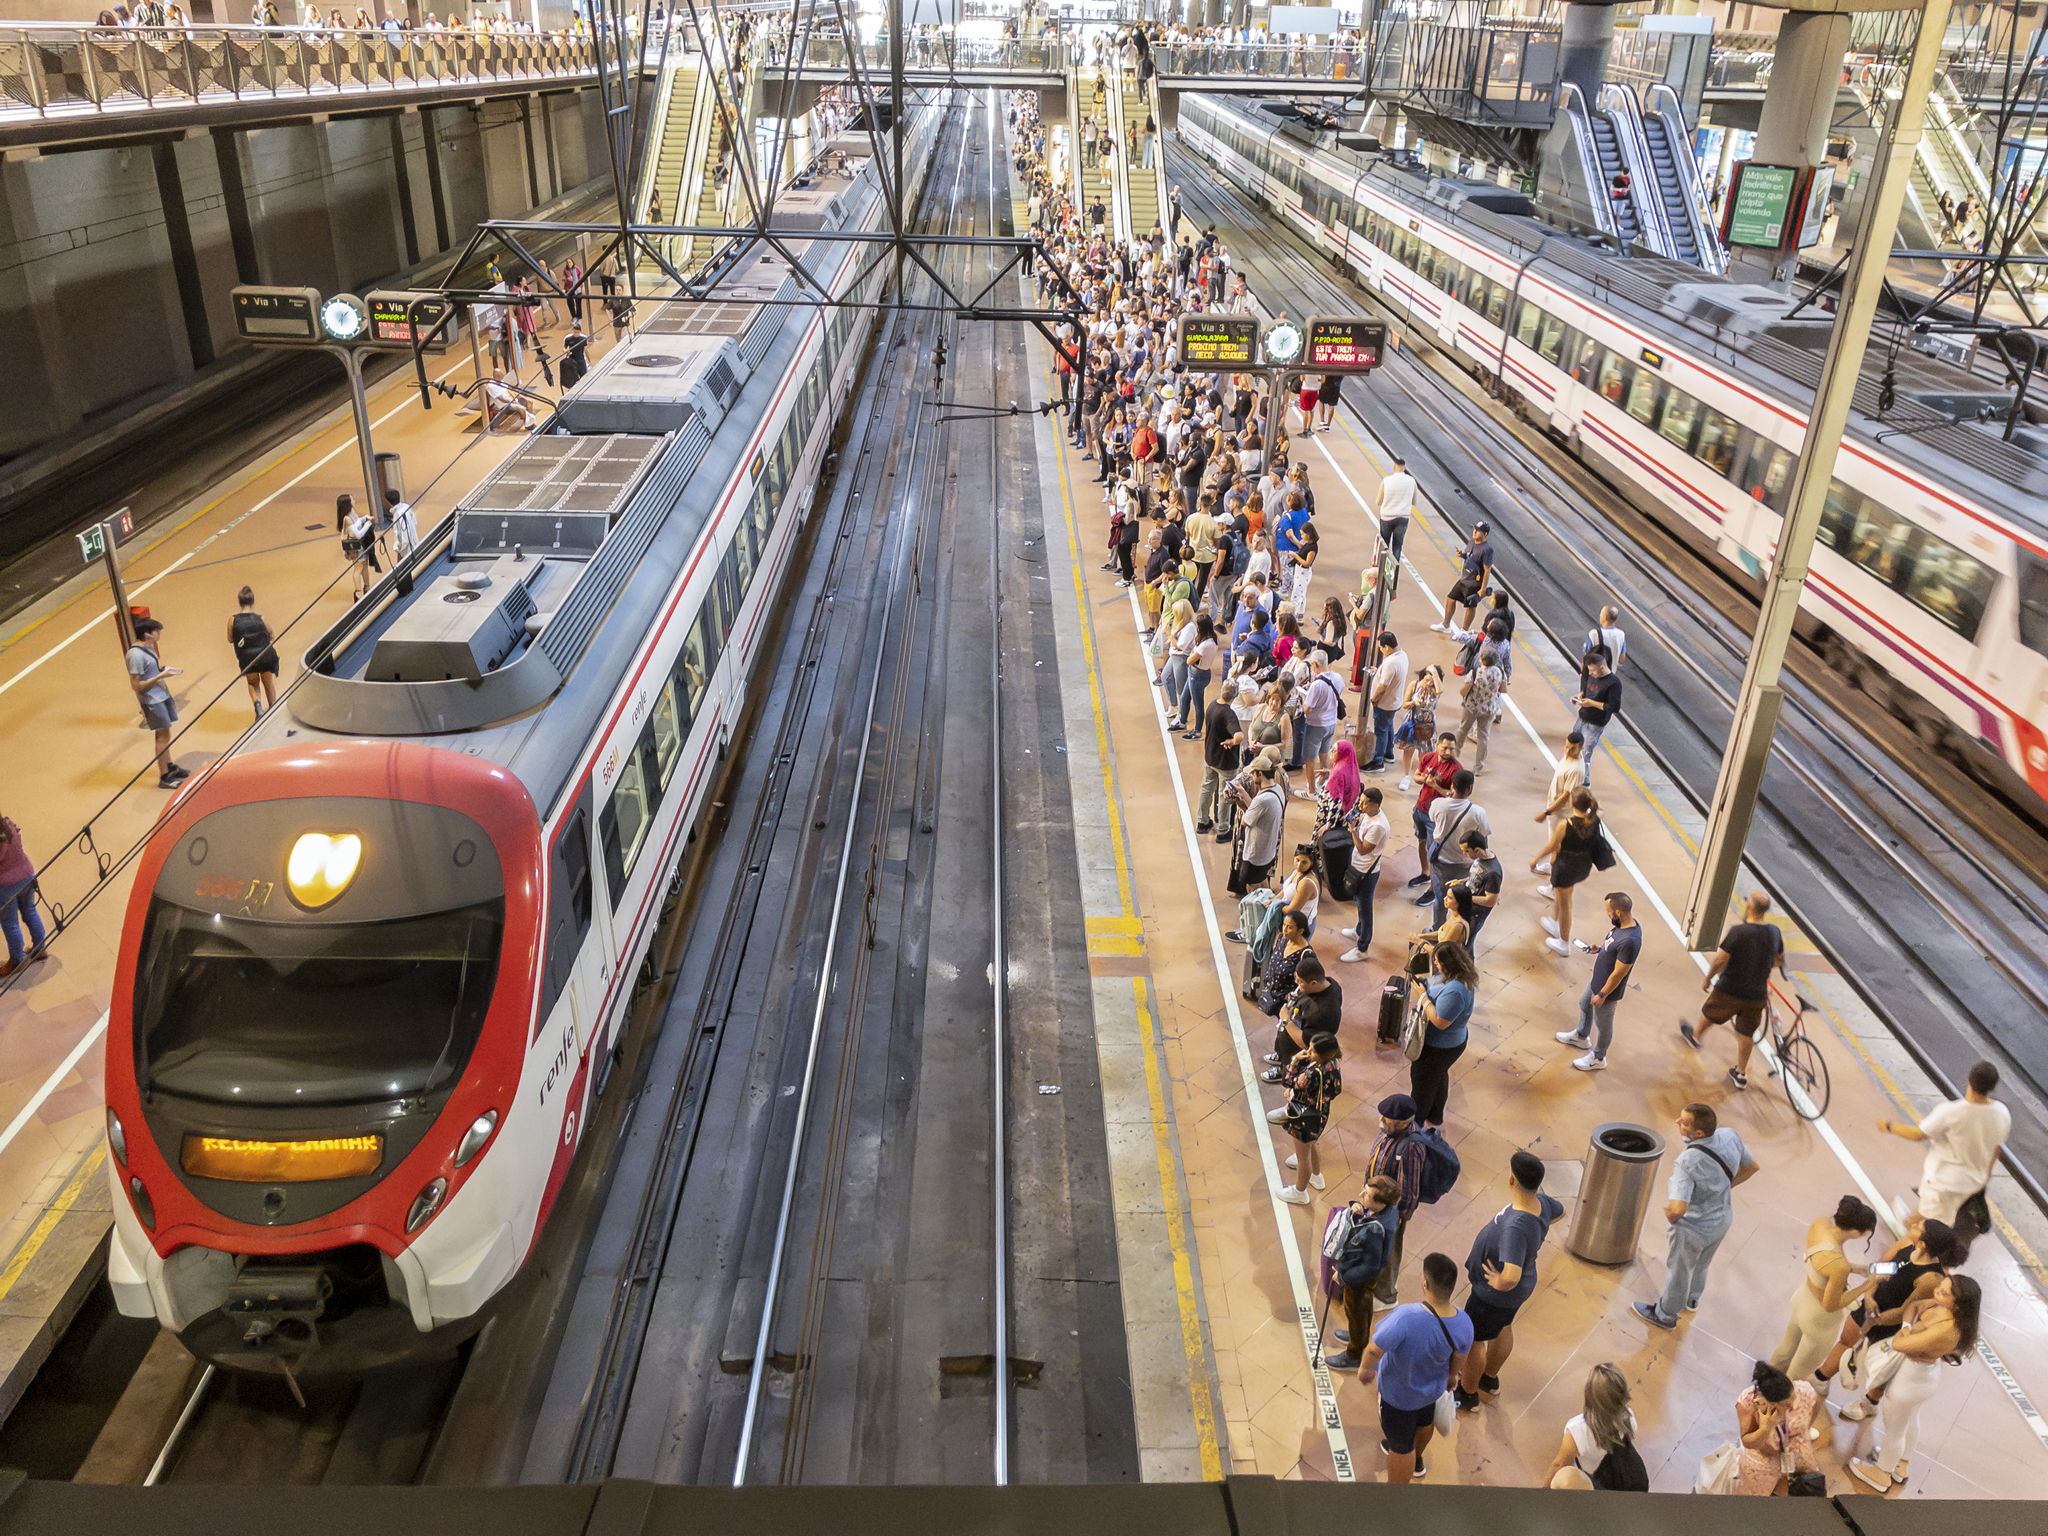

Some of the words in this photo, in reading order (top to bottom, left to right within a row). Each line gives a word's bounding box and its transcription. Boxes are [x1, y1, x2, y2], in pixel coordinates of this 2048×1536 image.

[1745, 171, 1764, 180] Más
[1765, 173, 1783, 181] vale
[1744, 180, 1771, 190] ladrillo
[1742, 190, 1766, 198] mano
[1767, 192, 1784, 200] que
[1740, 199, 1764, 207] cripto
[1739, 208, 1772, 217] volando
[273, 297, 278, 306] 1
[1219, 323, 1225, 332] 3
[1345, 325, 1352, 334] 4
[1186, 334, 1229, 342] GUADALAJARA
[1188, 342, 1217, 351] PROXIMO
[1315, 345, 1333, 353] ESTE
[1330, 353, 1355, 361] PARADA
[631, 687, 648, 726] renfe
[602, 745, 620, 785] 566M
[540, 1025, 574, 1107] renfe
[1299, 1306, 1318, 1330] LINE
[1306, 1331, 1323, 1353] THE
[1993, 1366, 2010, 1377] DE
[2001, 1379, 2019, 1390] LA
[1322, 1399, 1341, 1429] KEEP
